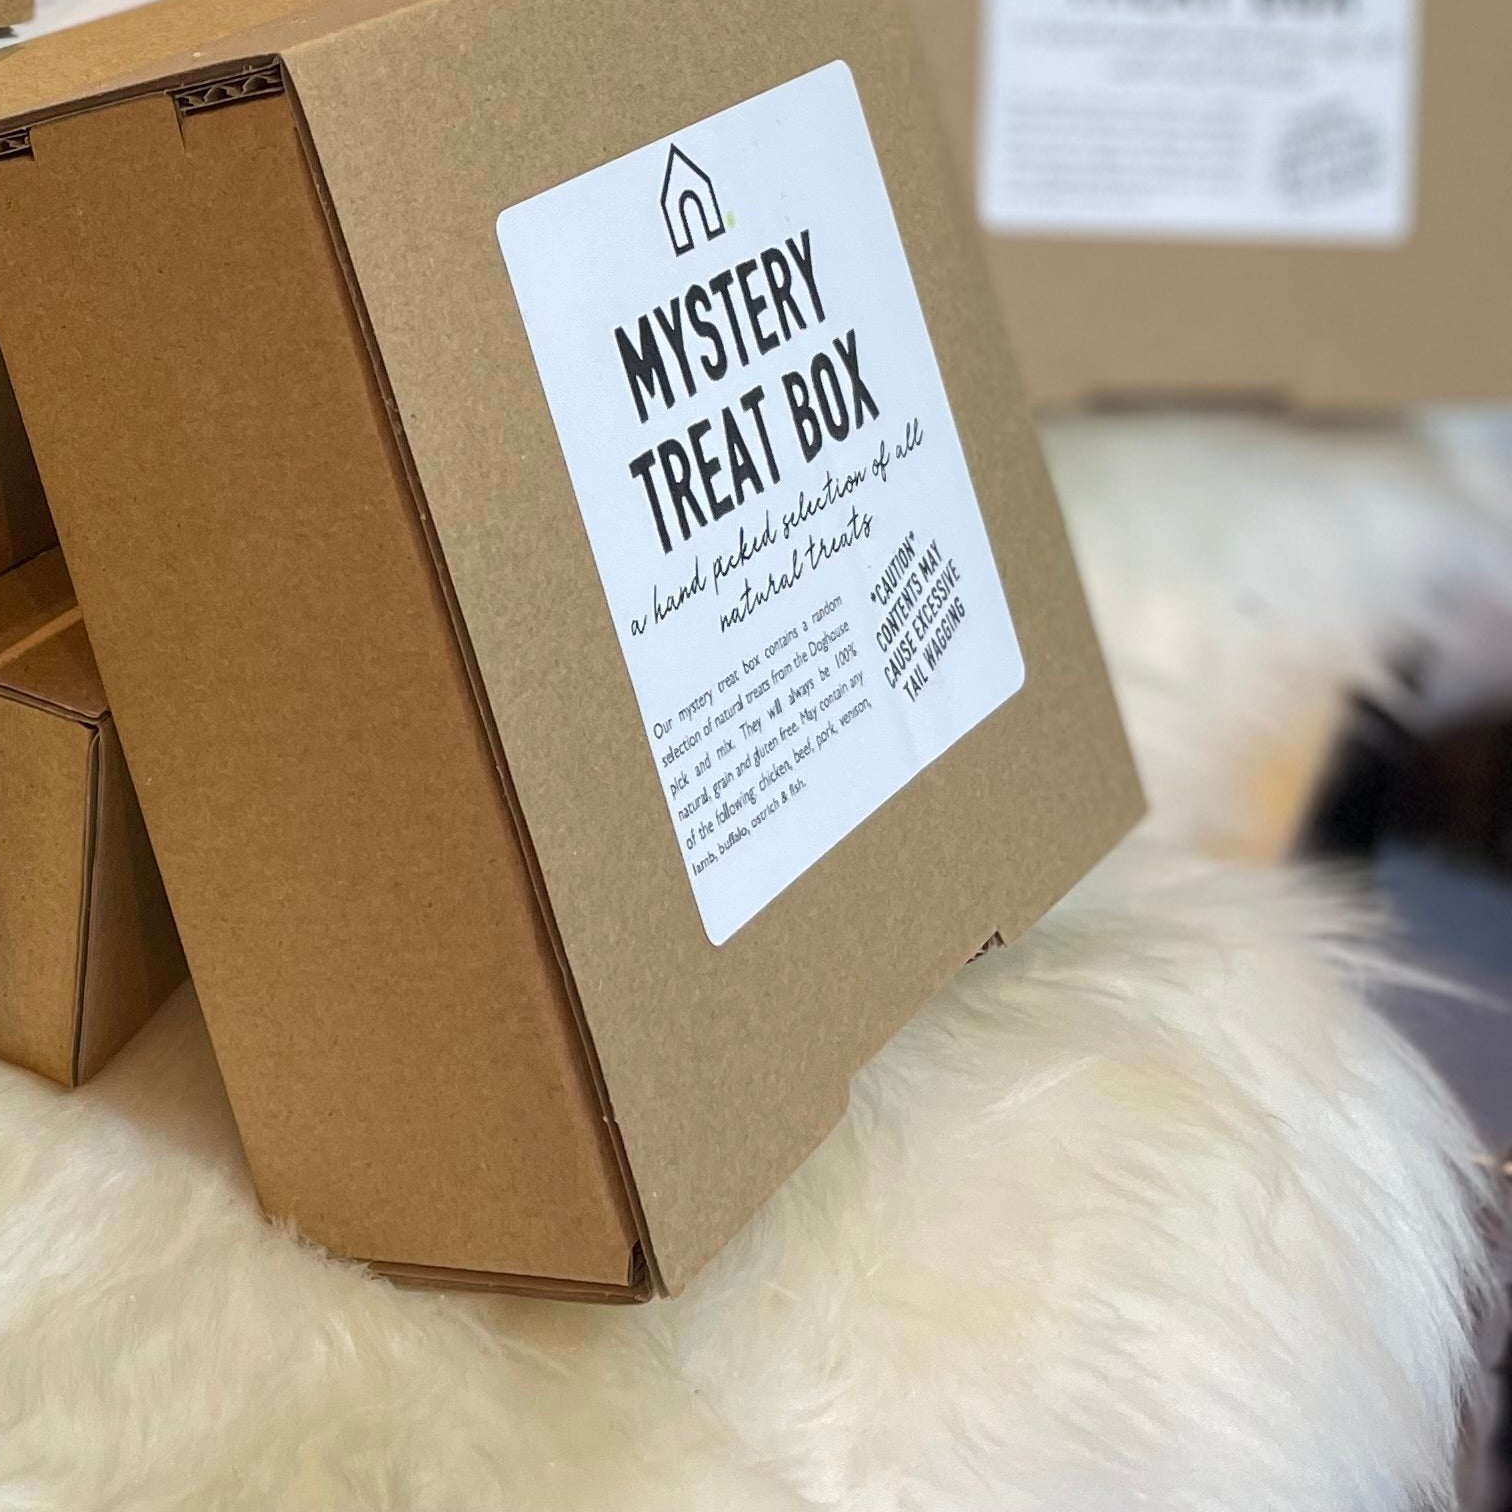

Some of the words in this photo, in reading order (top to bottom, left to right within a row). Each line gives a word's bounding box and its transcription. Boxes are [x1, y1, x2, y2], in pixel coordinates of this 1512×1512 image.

[615, 227, 825, 425] MYSTERY
[629, 385, 781, 556] TREAT
[781, 328, 880, 465] BOX
[630, 613, 647, 637] a
[653, 555, 707, 624] hand
[713, 510, 777, 596] picked
[782, 467, 866, 540] selection
[871, 439, 890, 484] of
[895, 417, 922, 459] all
[720, 550, 803, 632] natural
[805, 506, 872, 570] treats
[878, 572, 923, 653] CONTENTS
[919, 539, 941, 584] MAY
[652, 717, 672, 739] Our
[678, 688, 712, 722] mystery
[717, 670, 739, 693] treat
[742, 655, 761, 674] box
[765, 628, 798, 659] contains
[802, 621, 809, 633] a
[812, 597, 842, 625] random
[661, 731, 700, 766] selection
[702, 716, 713, 737] of
[714, 694, 744, 727] natural
[746, 680, 771, 704] treats
[772, 664, 793, 685] from
[793, 651, 809, 670] the
[809, 622, 850, 657] Doghouse
[886, 631, 918, 688] CAUSE
[912, 558, 959, 642] EXCESSIVE
[905, 663, 929, 703] TAIL
[923, 596, 965, 670] WAGGING
[669, 769, 688, 798] pick
[693, 750, 711, 776] and
[716, 738, 735, 758] mix.
[739, 716, 761, 738] They
[767, 696, 783, 719] will
[788, 678, 814, 704] always
[818, 666, 832, 681] be
[835, 642, 857, 668] 100%
